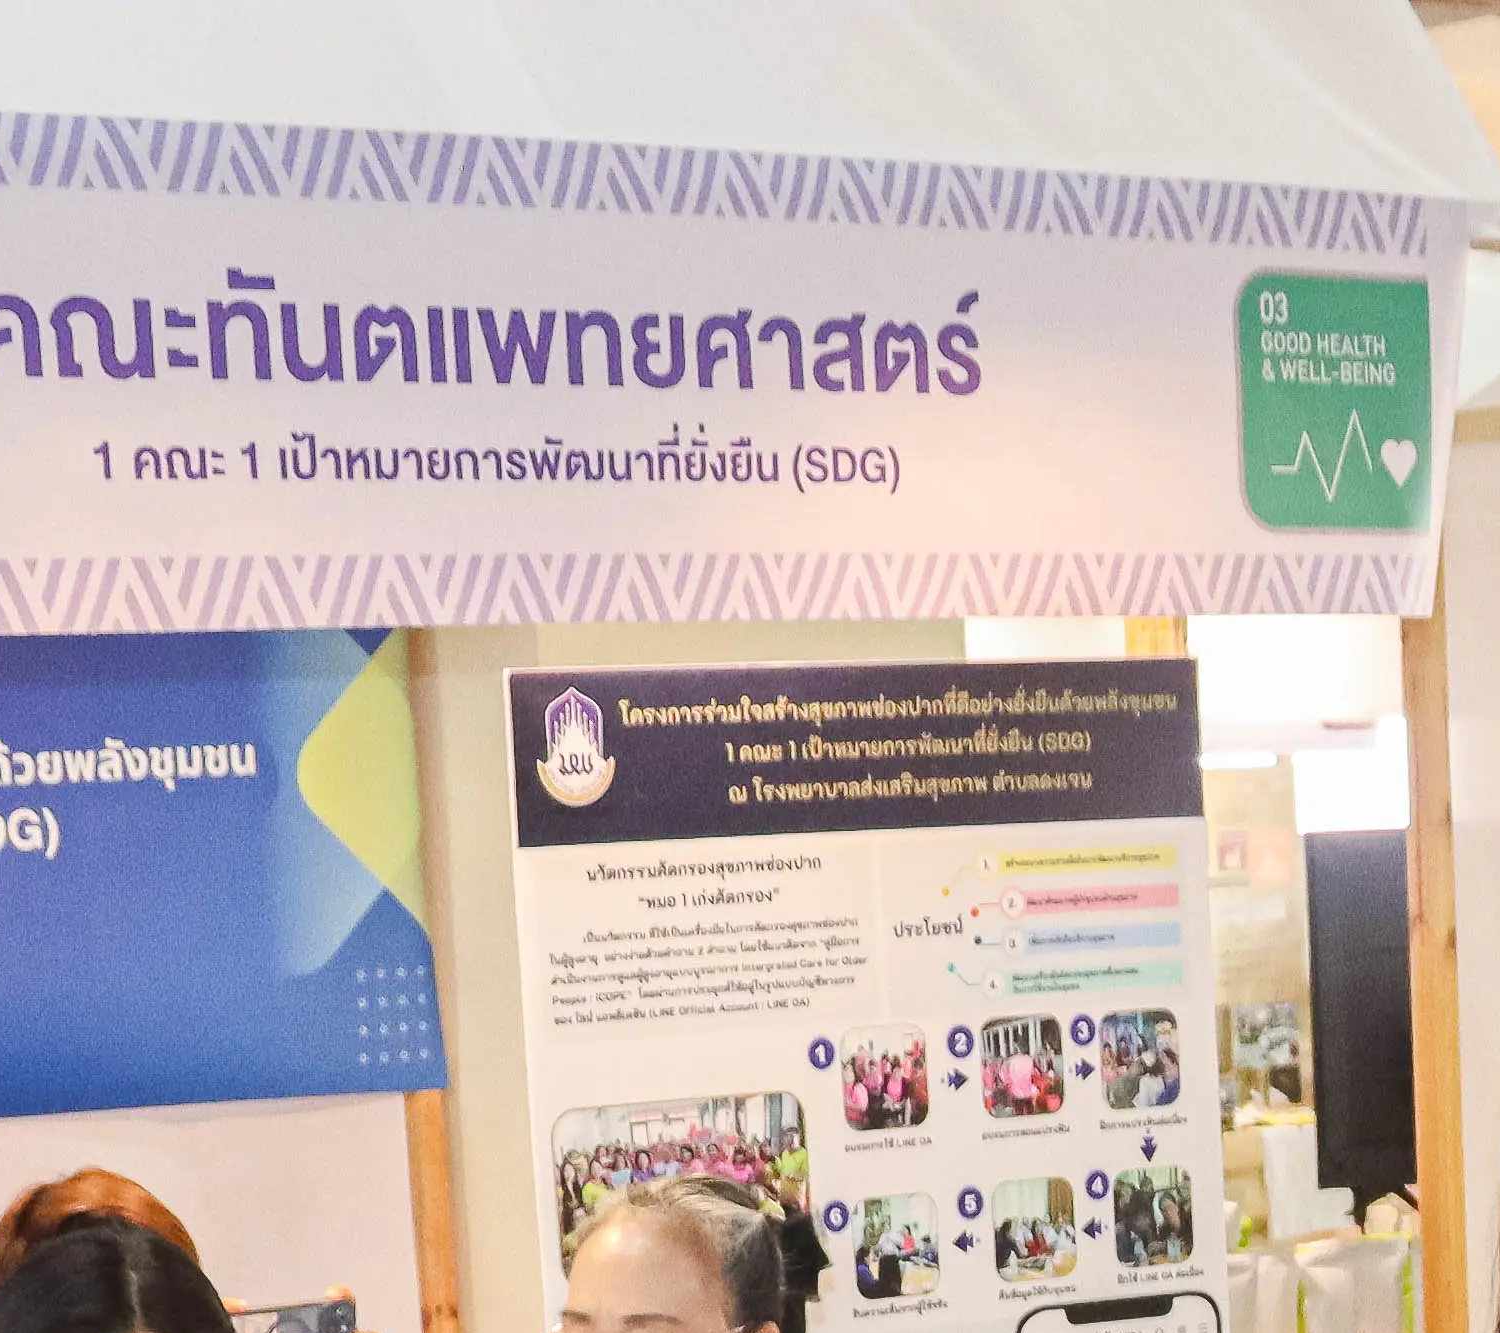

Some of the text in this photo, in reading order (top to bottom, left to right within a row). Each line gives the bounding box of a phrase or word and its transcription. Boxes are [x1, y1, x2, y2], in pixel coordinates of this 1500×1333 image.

[1259, 291, 1289, 324] 03
[1260, 331, 1387, 357] GOOD HEALTH
[1262, 358, 1397, 386] & WELL-BEING
[95, 424, 901, 494] 1 คณะ 1 เป้าหมายการพัฒนาที่ยั่งยืน (SDG)
[739, 743, 783, 765] คณะ
[586, 855, 822, 883] นวัตกรรมคัดกรองสุขภาพช่องปาก
[892, 913, 965, 940] ประโยชน์
